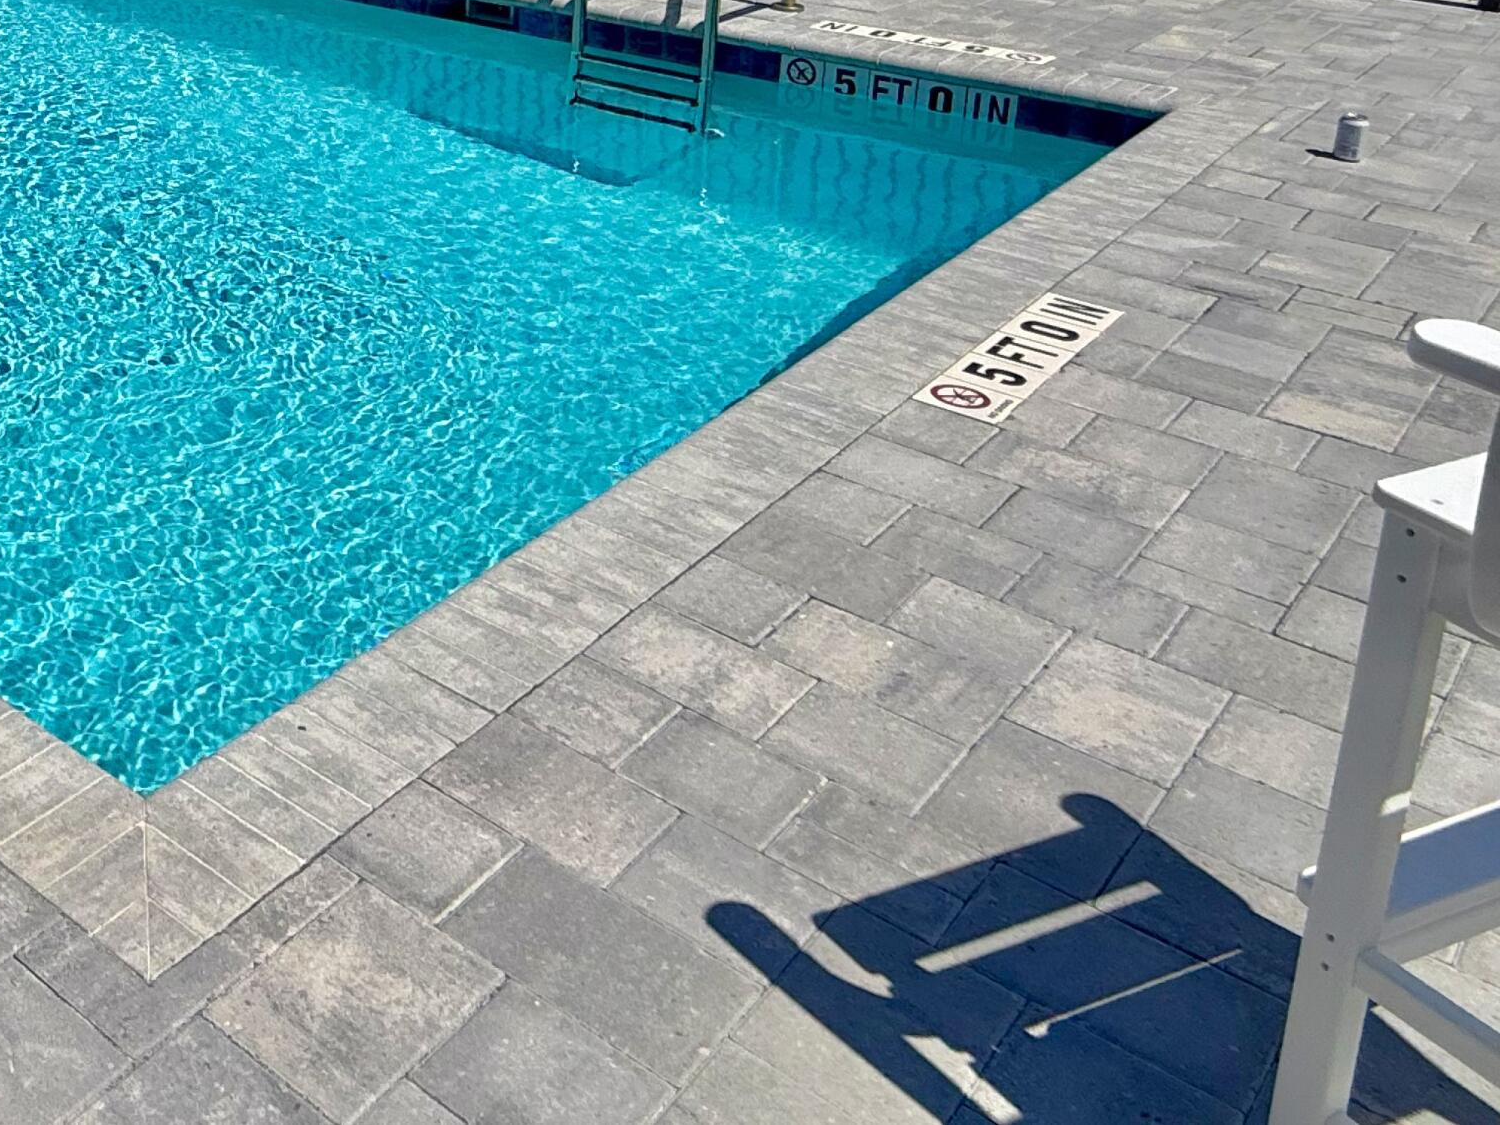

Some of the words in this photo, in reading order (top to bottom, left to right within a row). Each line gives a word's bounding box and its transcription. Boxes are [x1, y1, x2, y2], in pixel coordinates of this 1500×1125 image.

[834, 68, 856, 96] 5
[871, 76, 912, 106] FT
[928, 86, 952, 114] 0
[973, 92, 1011, 125] IN
[1040, 297, 1110, 326] IN
[1020, 320, 1080, 342] 0
[985, 336, 1060, 369] FT
[961, 362, 1028, 387] 5
